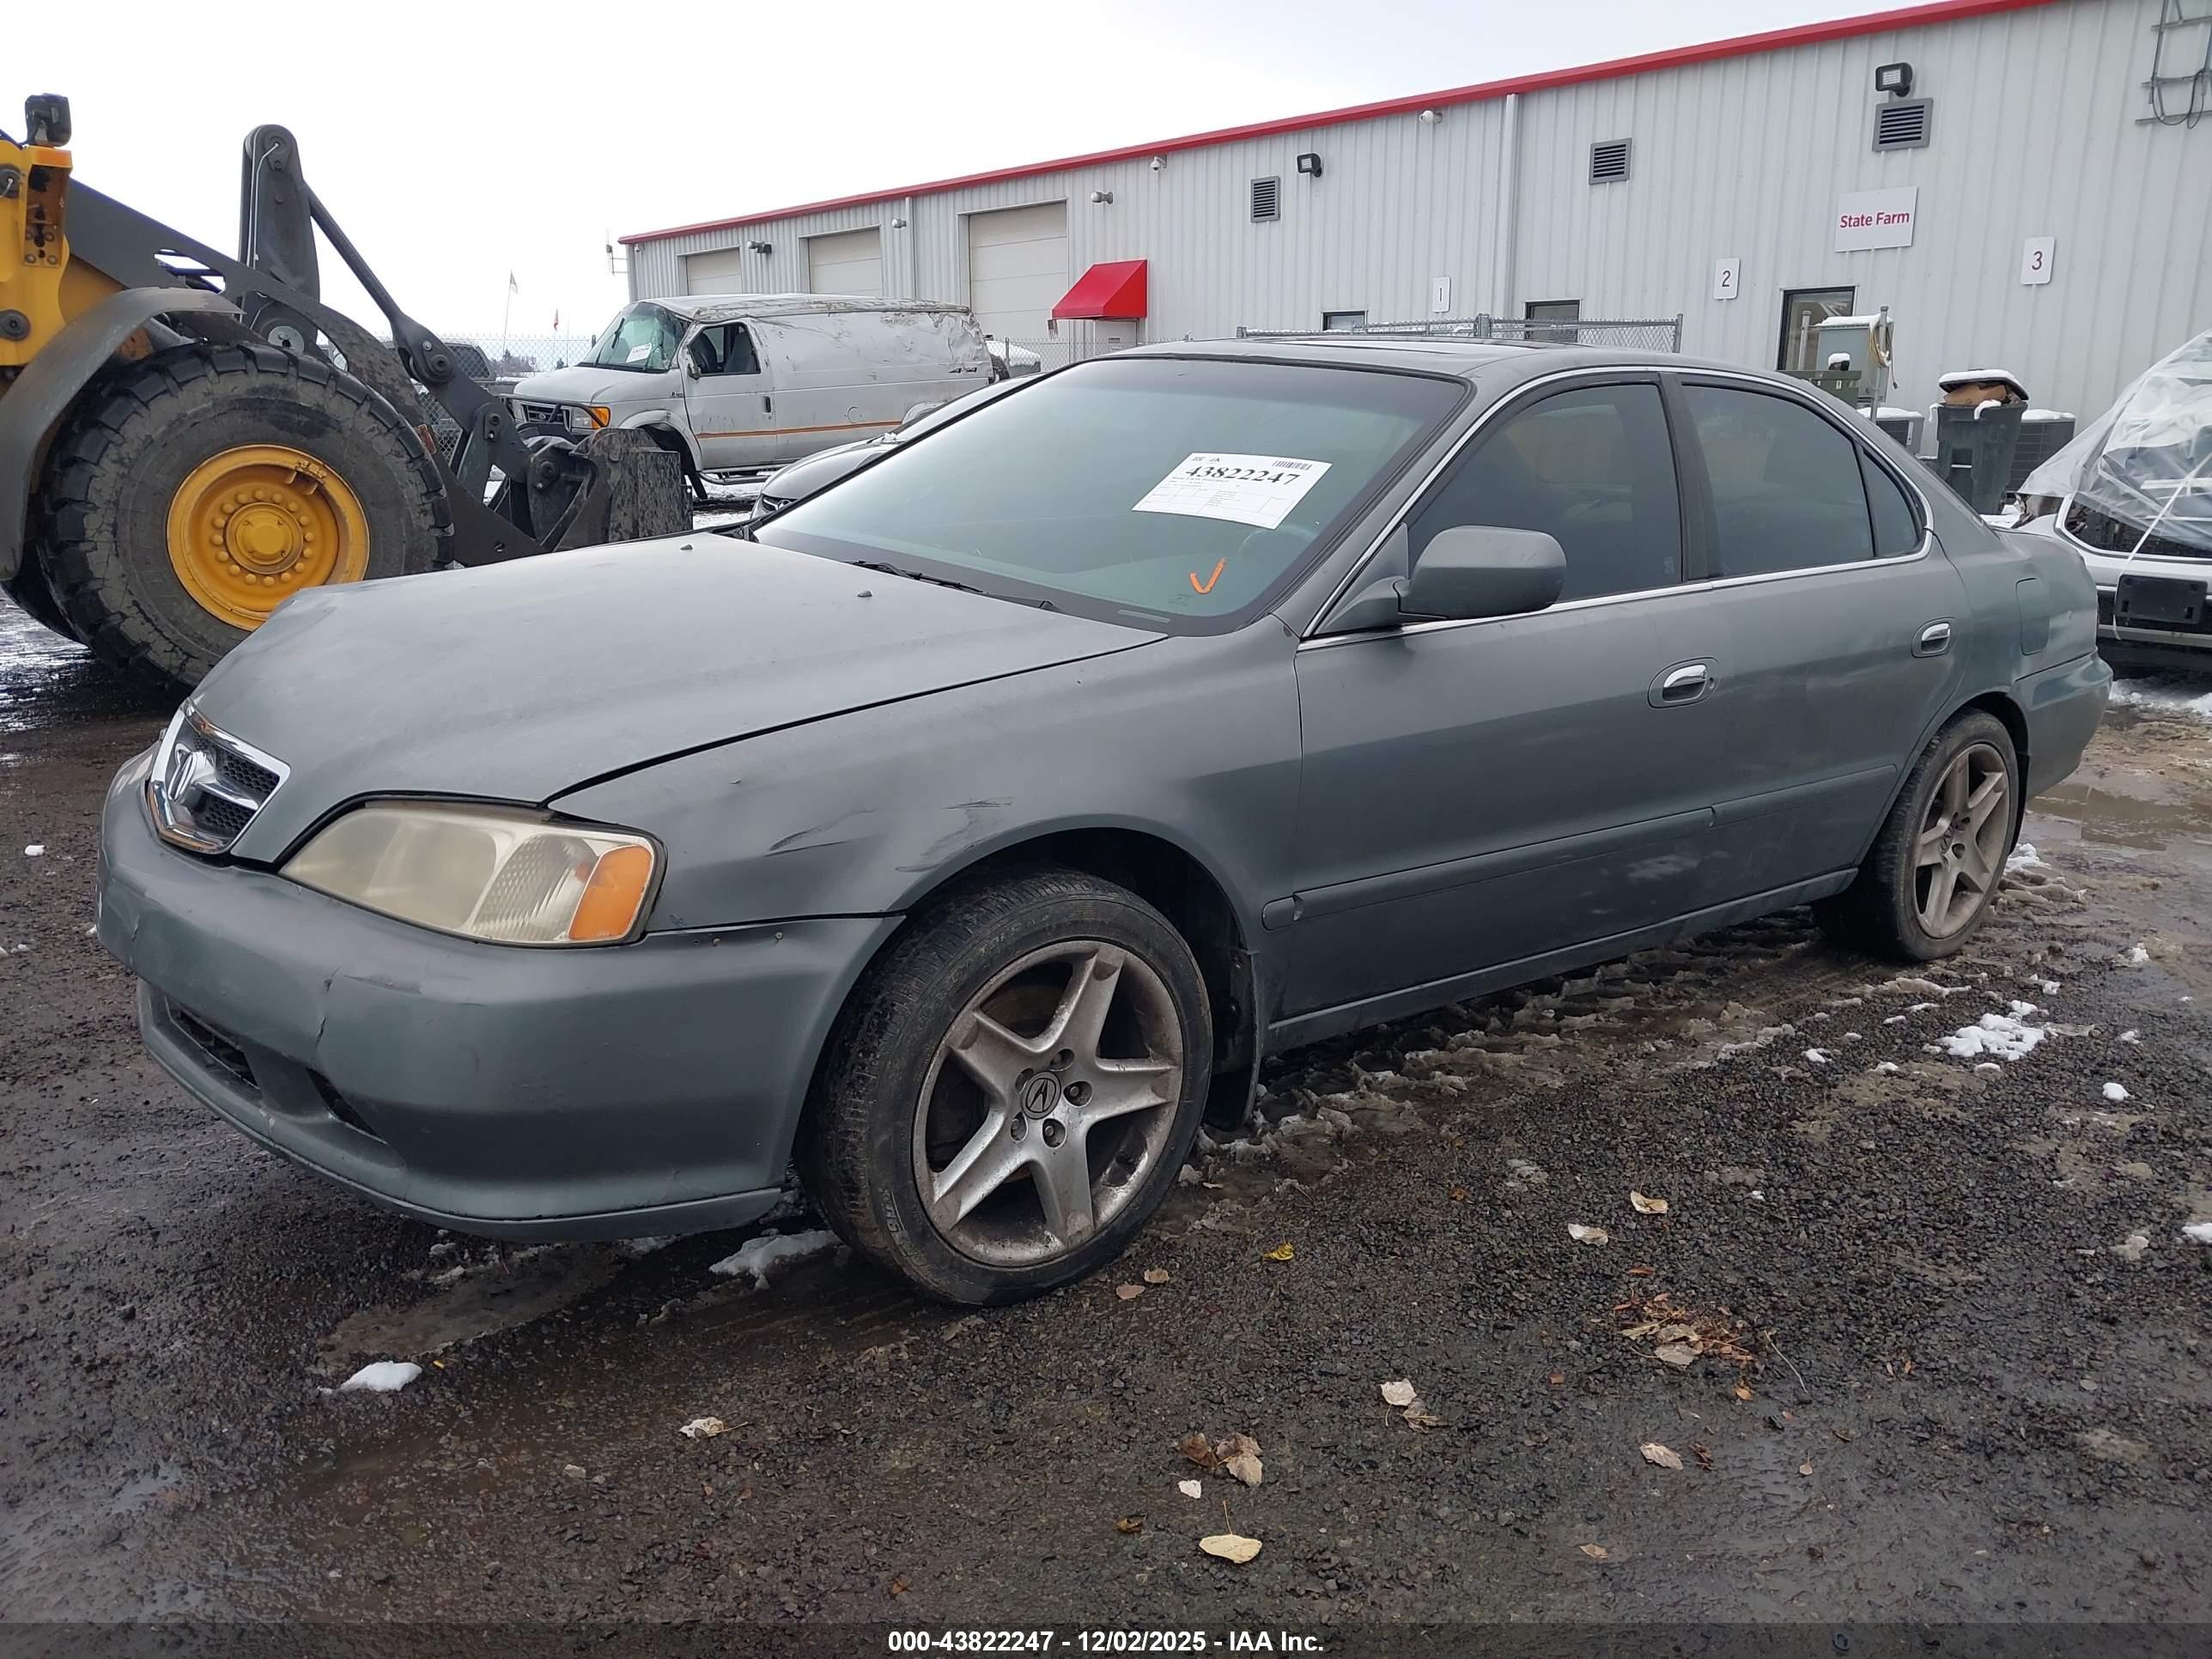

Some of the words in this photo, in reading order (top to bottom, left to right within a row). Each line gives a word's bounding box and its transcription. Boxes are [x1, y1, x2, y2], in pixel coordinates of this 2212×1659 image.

[1839, 214, 1873, 228] State
[1875, 211, 1911, 226] Farm
[2032, 250, 2043, 270] 3
[1721, 270, 1731, 288] 2
[1185, 465, 1302, 485] 43822247
